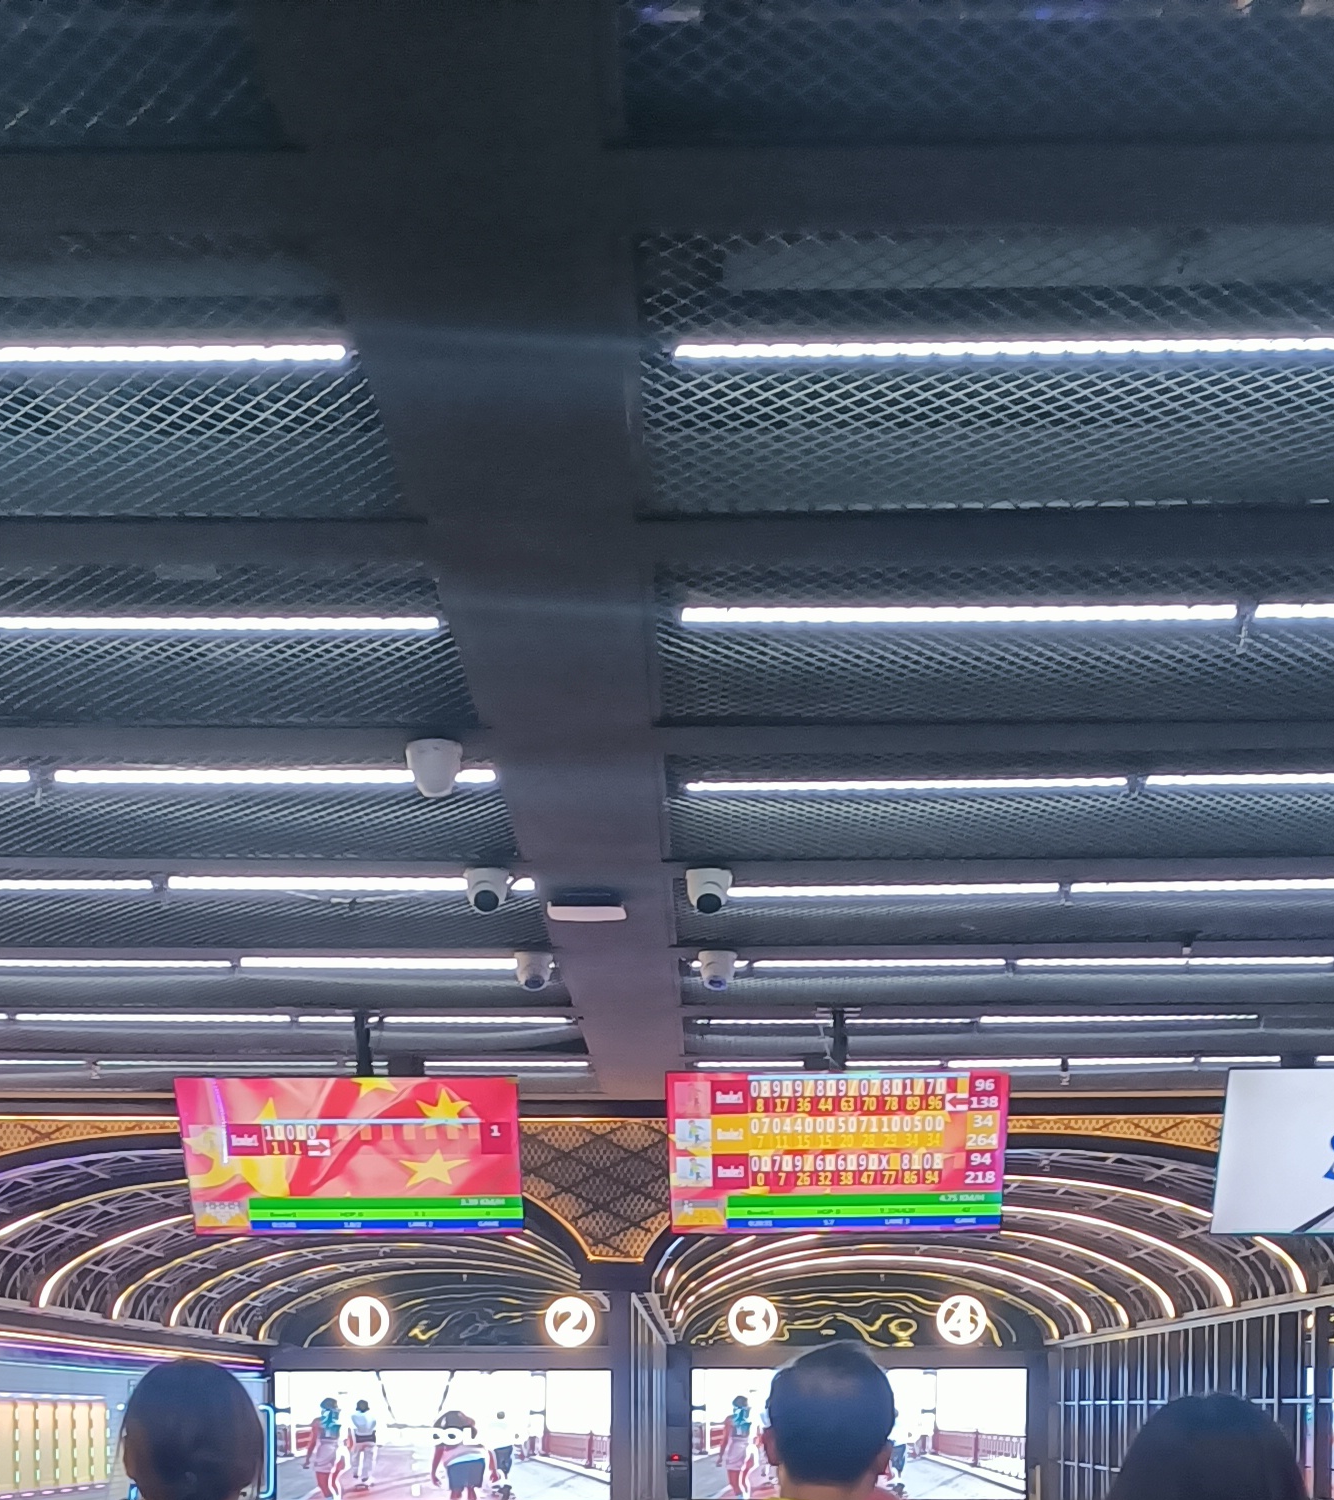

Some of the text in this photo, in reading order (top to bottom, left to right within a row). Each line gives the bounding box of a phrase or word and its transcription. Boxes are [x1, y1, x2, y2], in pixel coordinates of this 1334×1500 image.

[974, 1078, 996, 1092] 96
[973, 1114, 994, 1128] 34
[490, 1124, 502, 1137] 1
[271, 1141, 302, 1155] 1 1
[970, 1153, 992, 1166] 94
